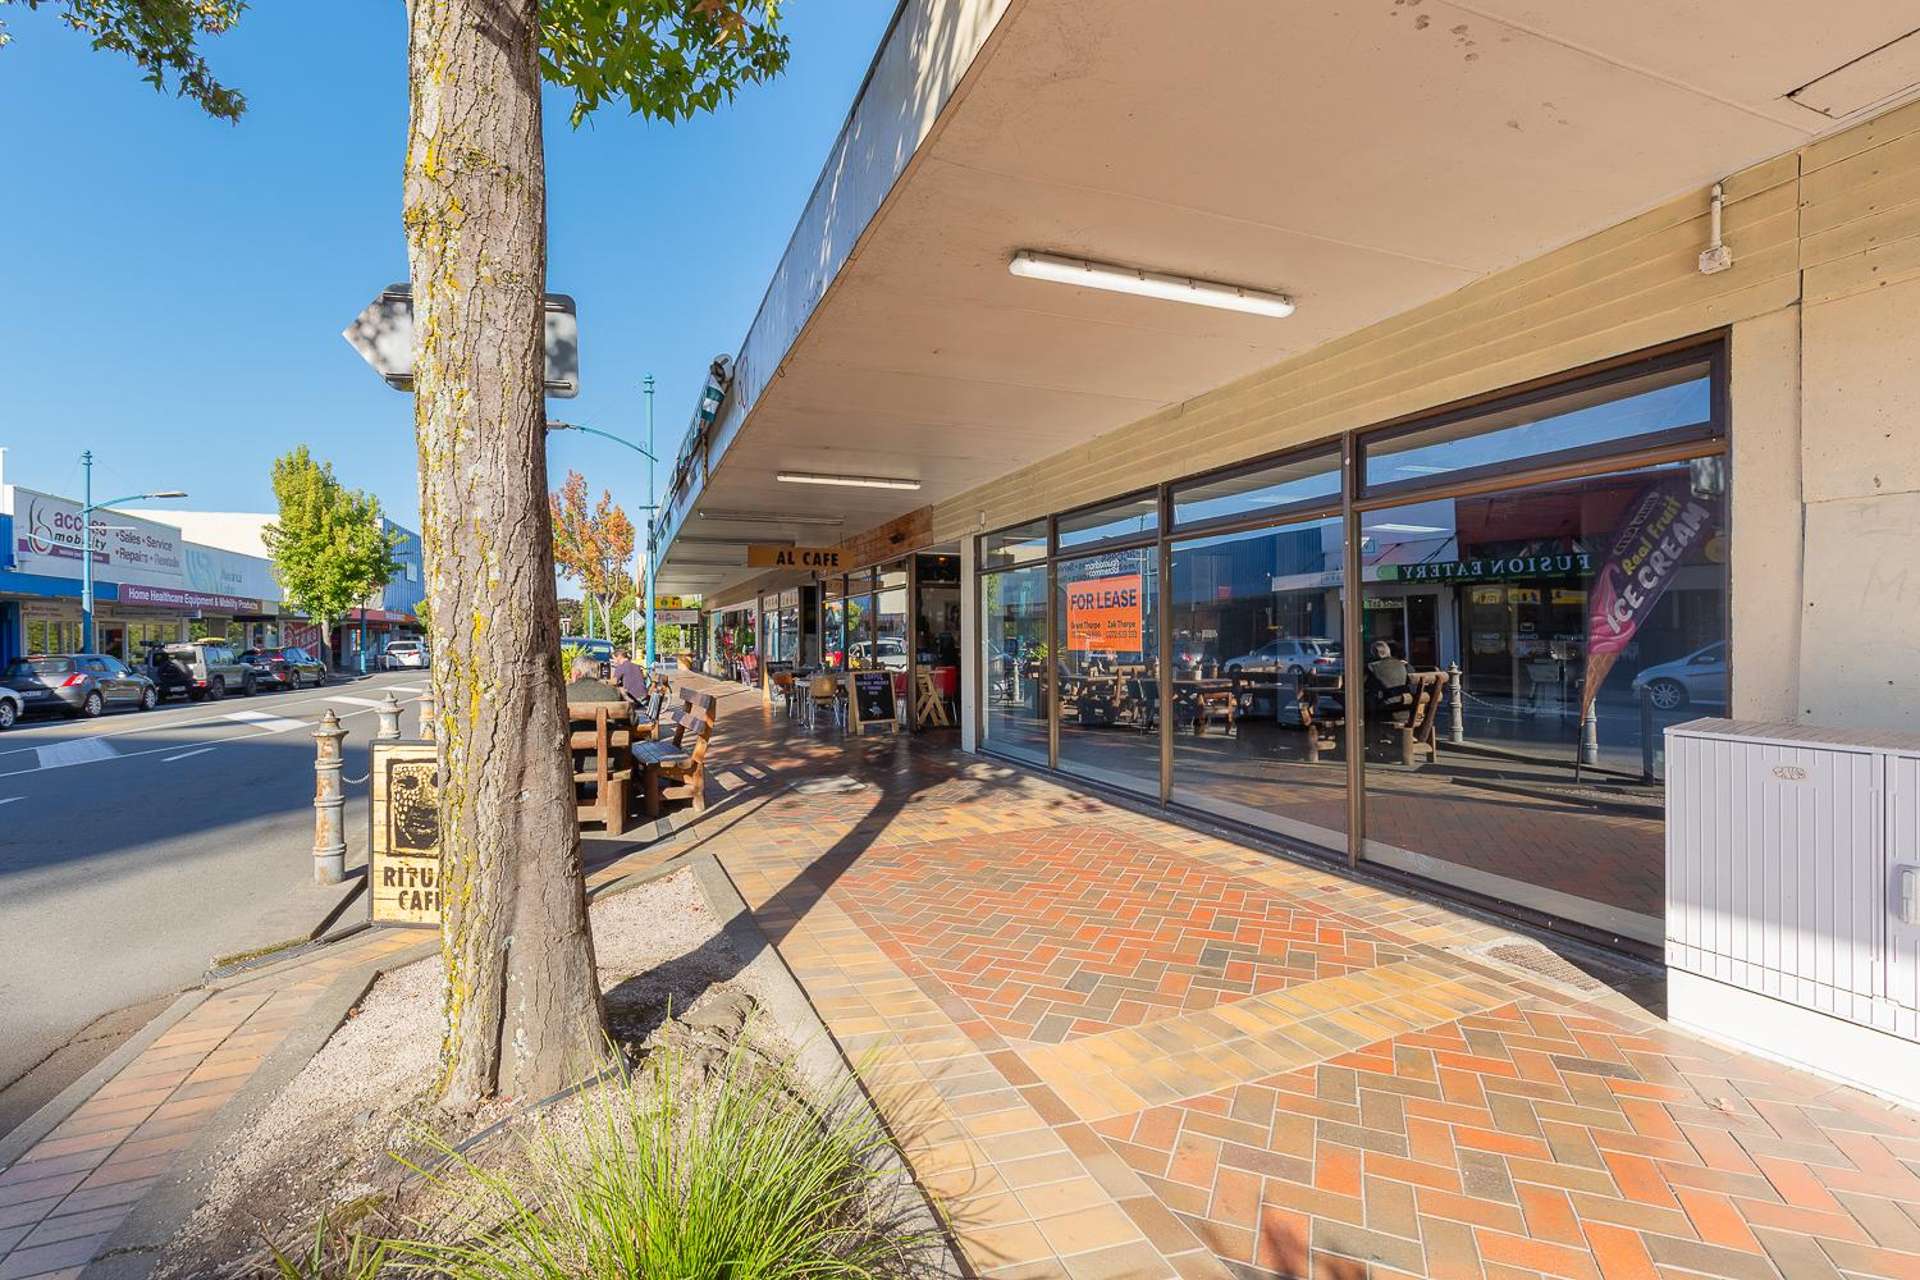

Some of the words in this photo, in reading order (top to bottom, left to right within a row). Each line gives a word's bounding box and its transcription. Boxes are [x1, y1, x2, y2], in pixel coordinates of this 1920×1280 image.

[54, 511, 108, 537] accss
[119, 529, 141, 545] Sales
[146, 535, 173, 552] Service
[1621, 536, 1653, 576] Real
[1646, 495, 1682, 539] Fruit
[119, 546, 149, 564] Repairs
[803, 551, 839, 567] CAFE
[1606, 583, 1646, 635] ICE
[1637, 501, 1711, 590] CREAM
[128, 588, 150, 600] Home
[150, 589, 184, 603] Healthcare
[184, 593, 214, 608] Equipment
[1071, 592, 1094, 610] FOR
[1096, 588, 1137, 609] LEASE
